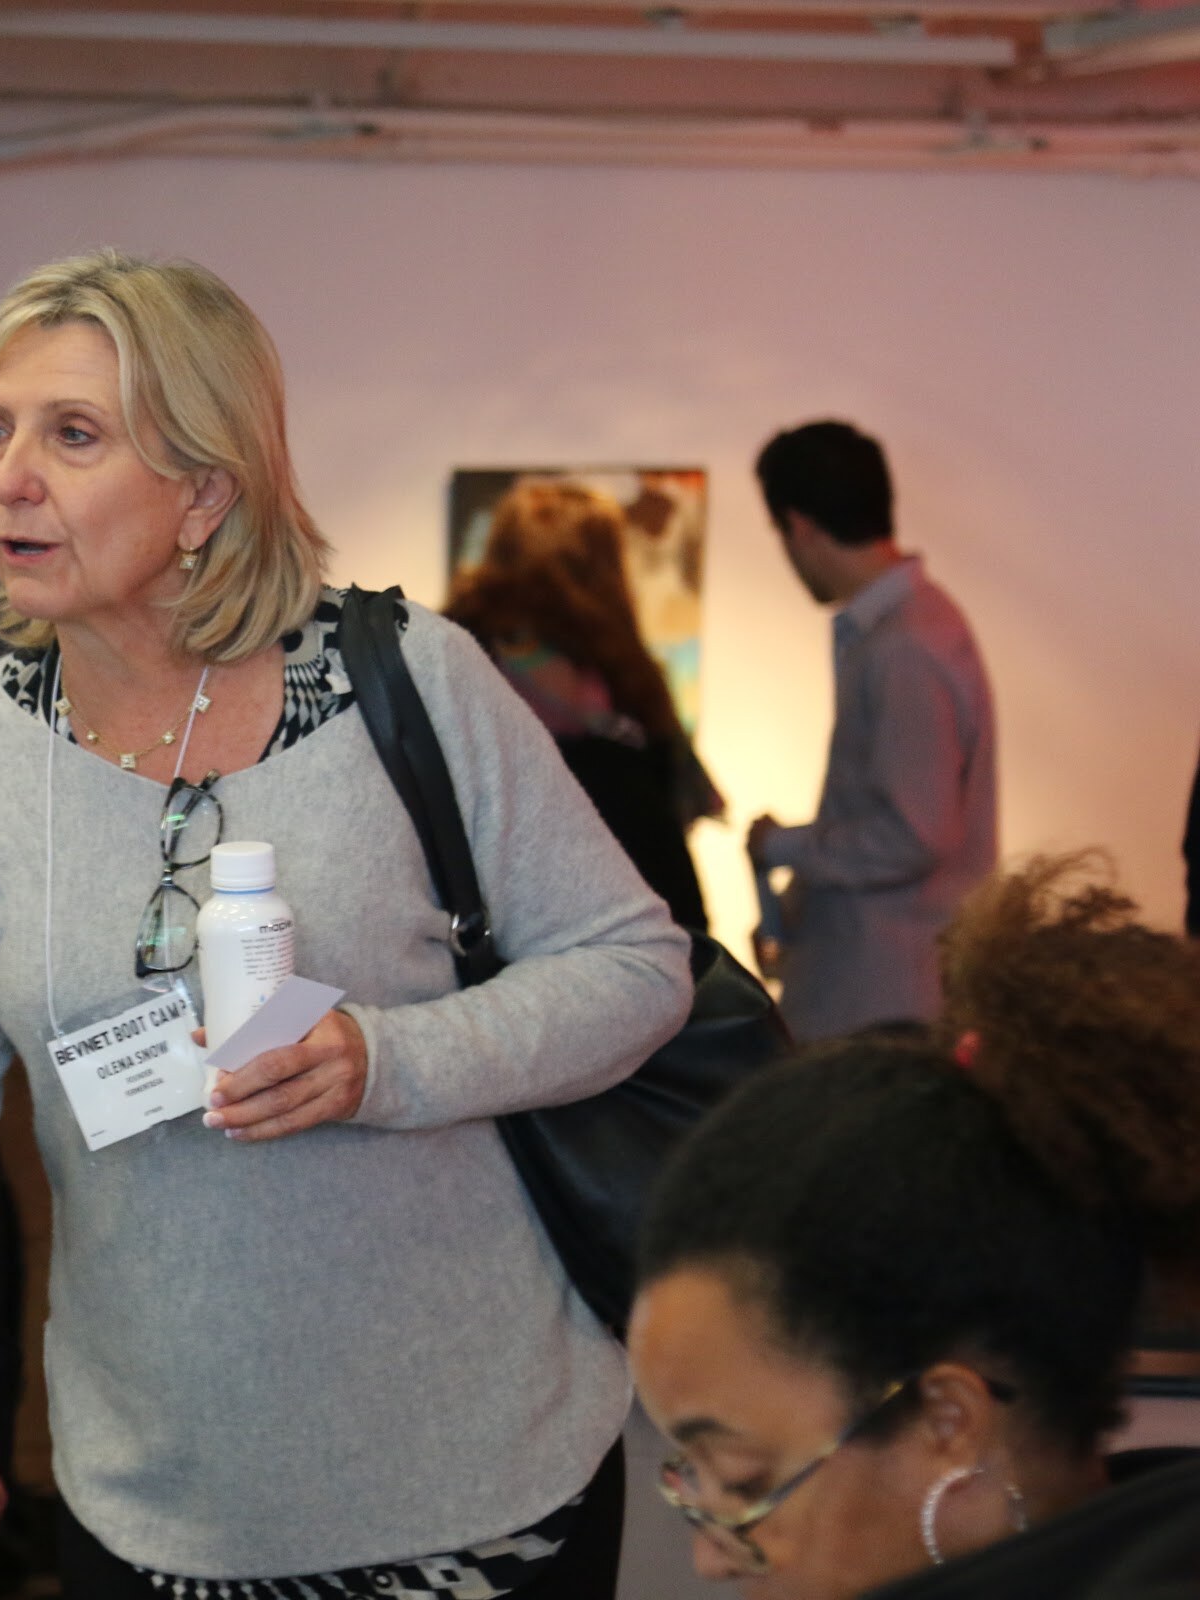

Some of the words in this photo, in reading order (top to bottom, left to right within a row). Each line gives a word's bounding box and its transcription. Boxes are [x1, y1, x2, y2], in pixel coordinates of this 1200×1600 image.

[54, 1031, 113, 1066] BEVNET
[112, 1015, 148, 1042] BOOT
[96, 1056, 135, 1080] OLENA
[134, 1040, 169, 1065] SNOW
